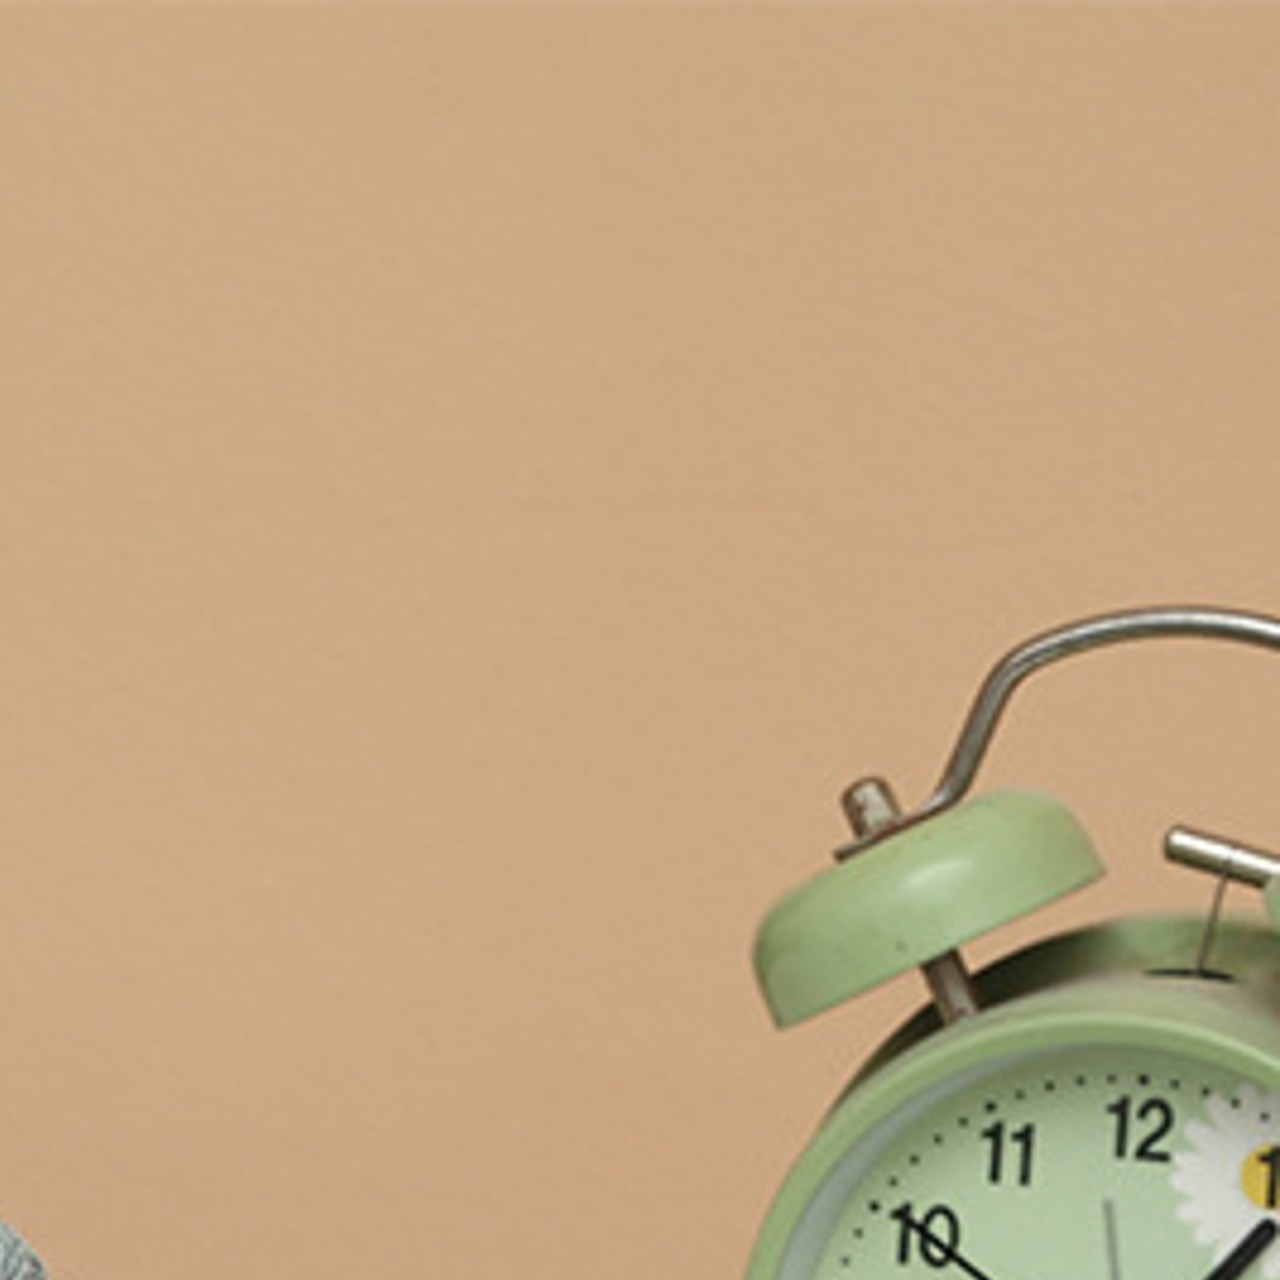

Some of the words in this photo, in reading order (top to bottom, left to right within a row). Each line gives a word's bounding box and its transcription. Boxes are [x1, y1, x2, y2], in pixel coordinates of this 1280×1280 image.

[980, 1120, 1036, 1187] 11
[1106, 1094, 1175, 1163] 12
[889, 1202, 961, 1269] 10
